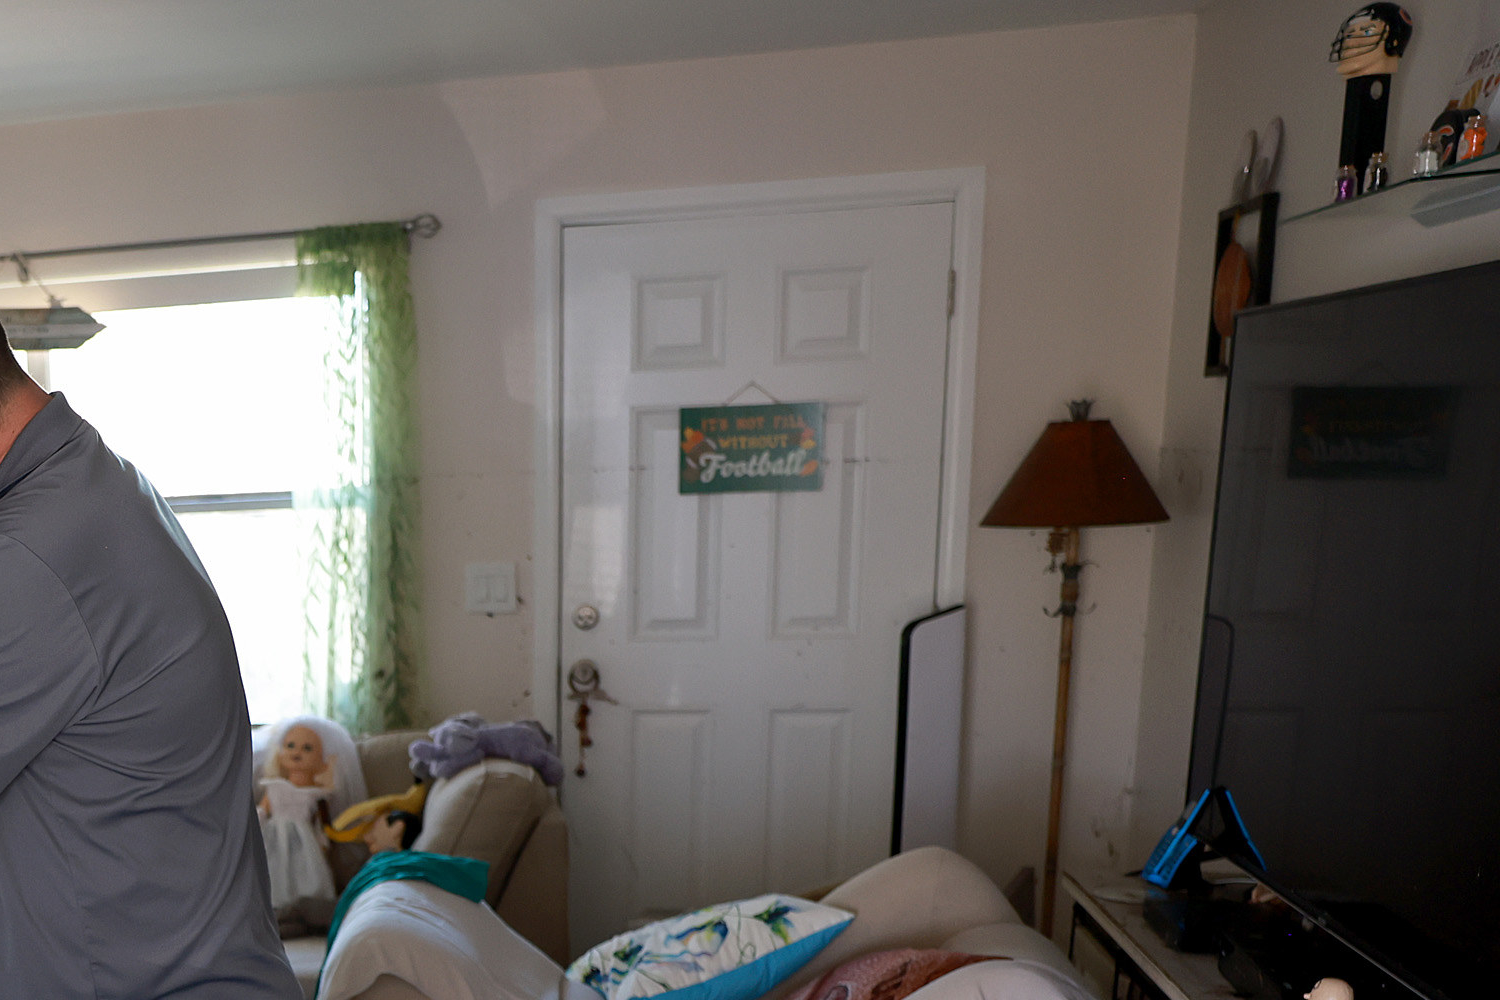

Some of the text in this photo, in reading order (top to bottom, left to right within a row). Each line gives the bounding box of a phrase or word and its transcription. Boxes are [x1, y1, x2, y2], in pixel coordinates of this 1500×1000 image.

[736, 416, 764, 430] NOT
[718, 434, 788, 449] WITHOUT
[699, 449, 807, 483] Football
